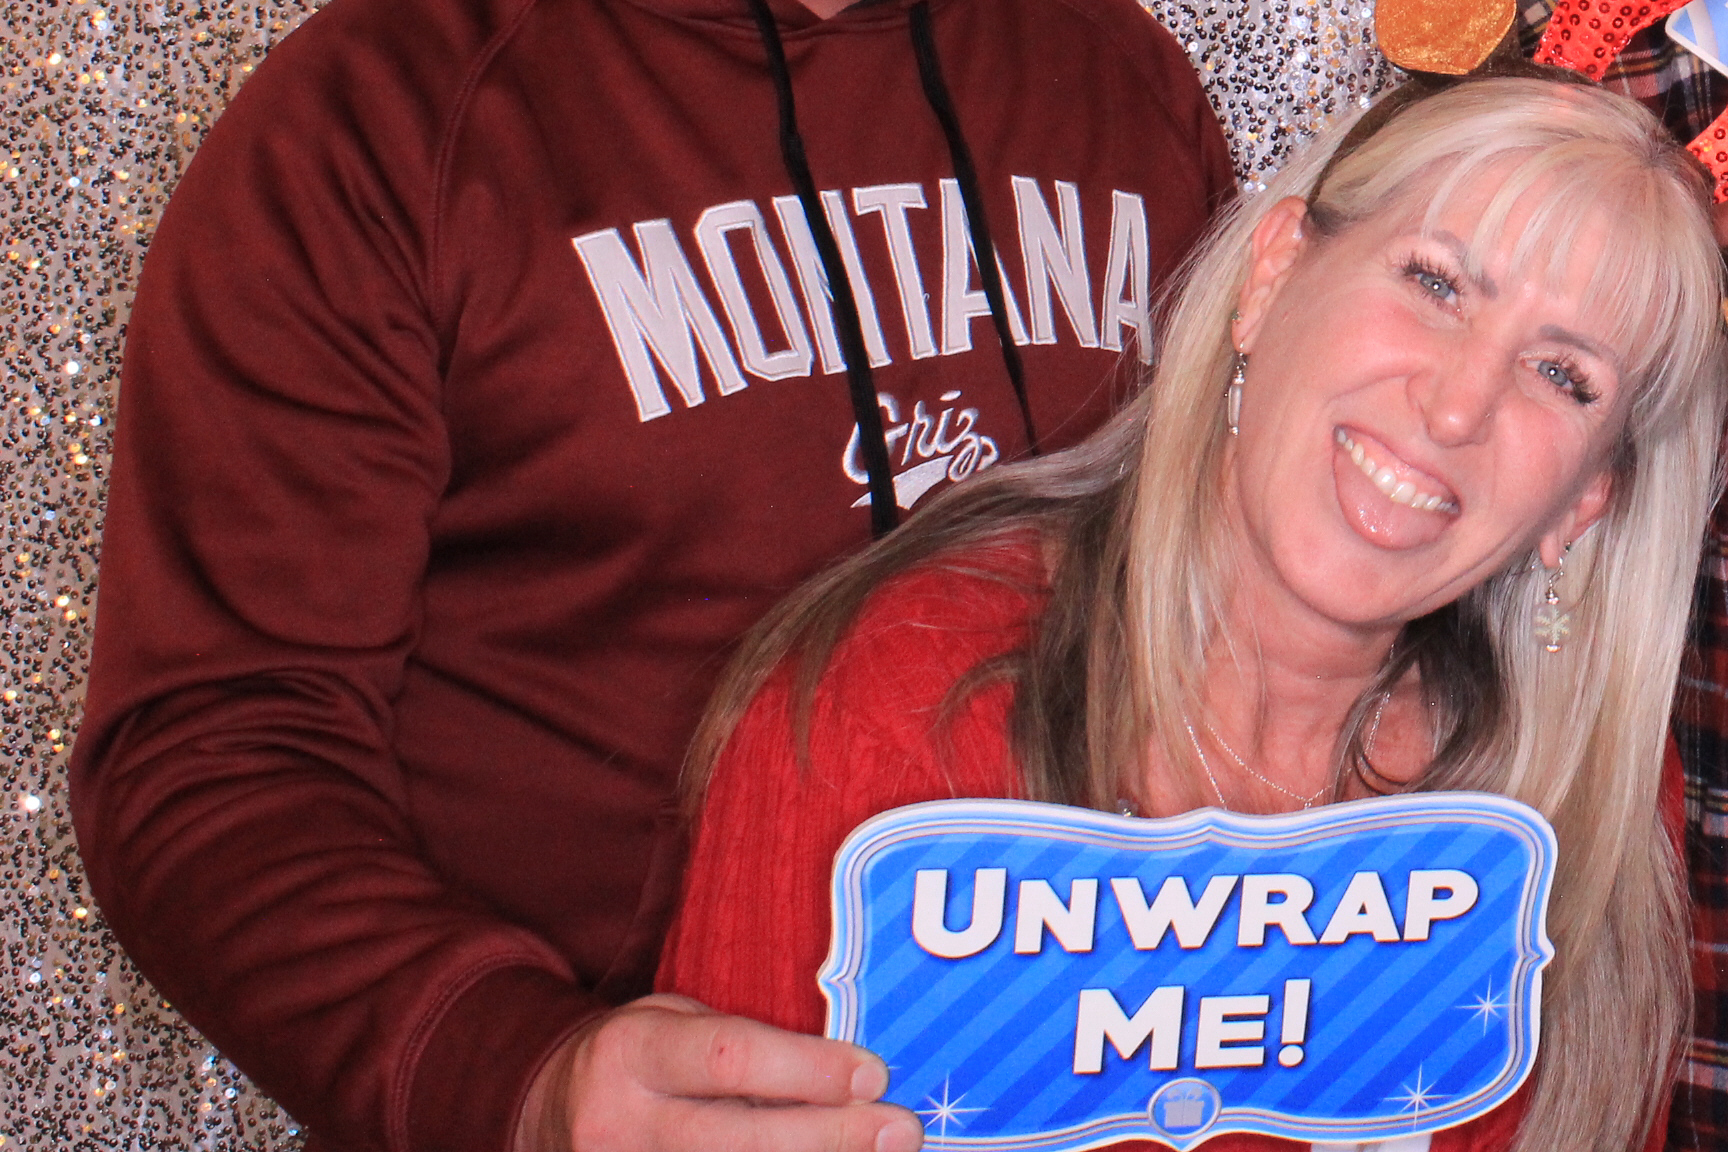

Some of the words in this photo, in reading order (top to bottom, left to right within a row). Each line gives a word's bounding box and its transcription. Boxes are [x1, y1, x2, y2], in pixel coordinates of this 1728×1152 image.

[572, 174, 1155, 423] MONTANA
[842, 389, 999, 484] Griz
[911, 867, 1480, 959] UNWRAP
[1072, 978, 1312, 1075] ME!
